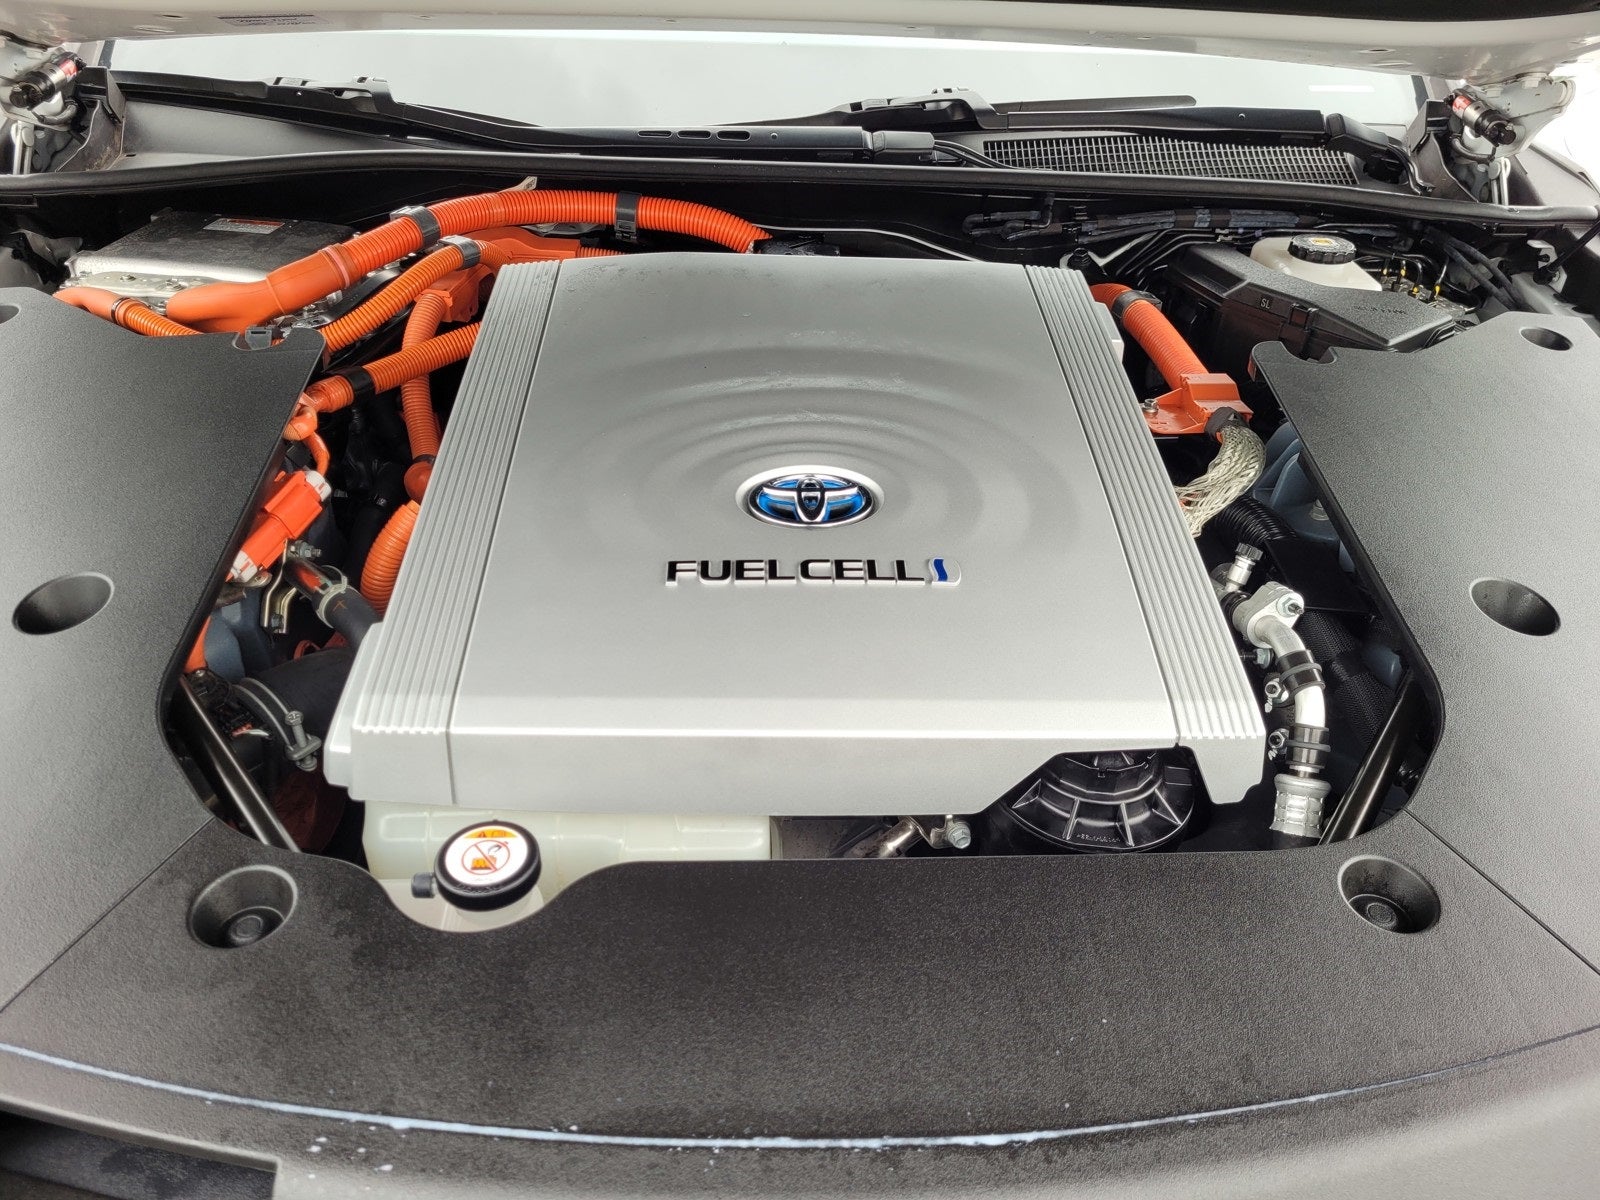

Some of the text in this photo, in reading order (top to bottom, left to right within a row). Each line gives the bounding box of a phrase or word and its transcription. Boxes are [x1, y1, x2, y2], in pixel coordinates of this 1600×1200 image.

[1260, 298, 1271, 309] SL
[666, 559, 926, 585] FUEL CELL
